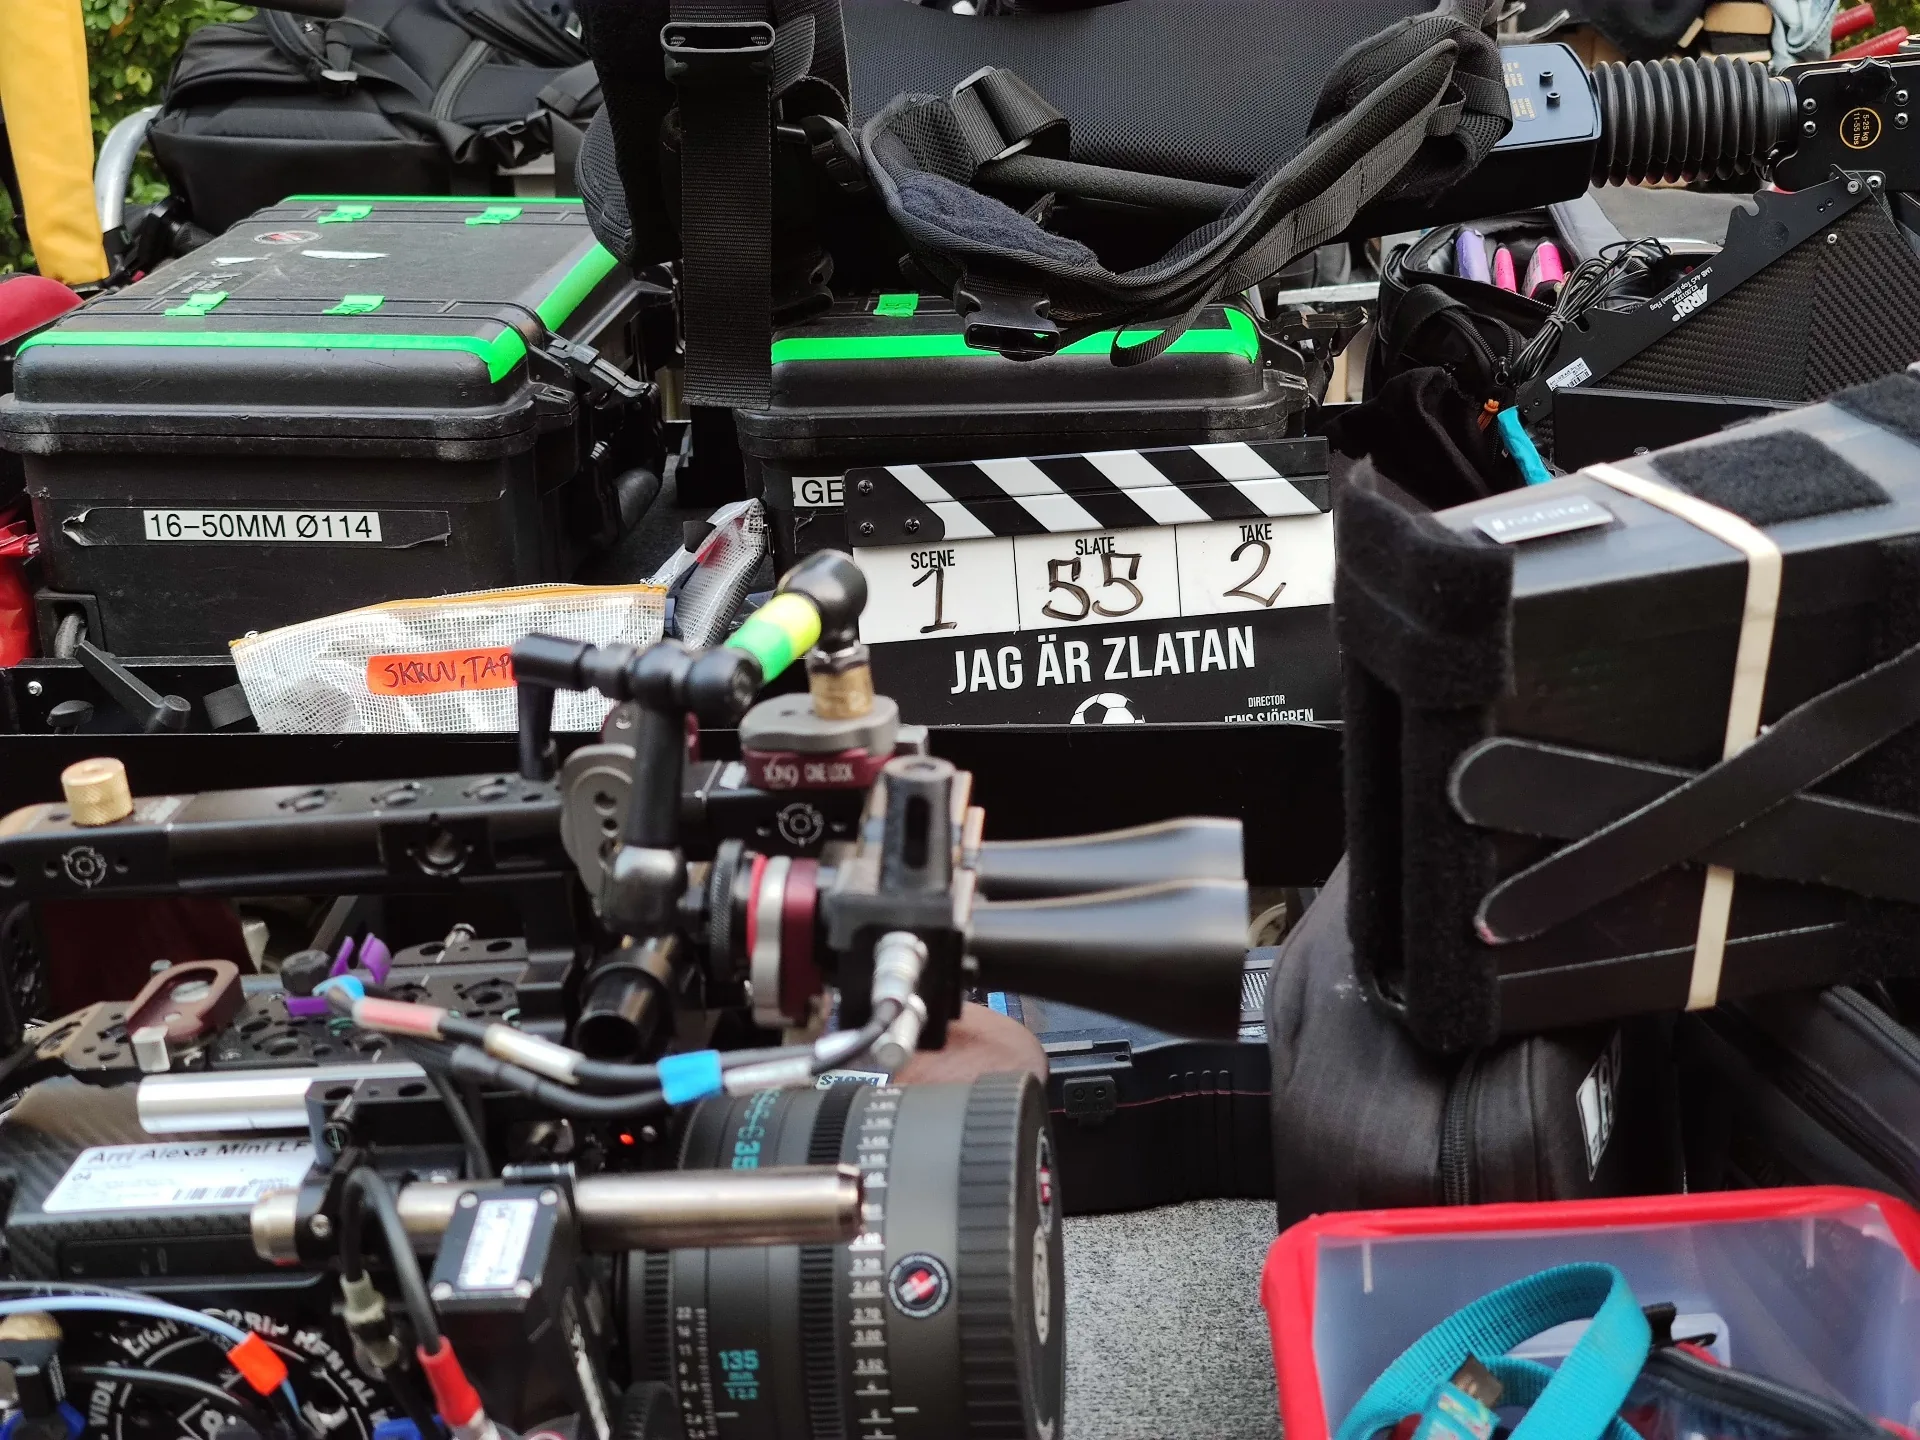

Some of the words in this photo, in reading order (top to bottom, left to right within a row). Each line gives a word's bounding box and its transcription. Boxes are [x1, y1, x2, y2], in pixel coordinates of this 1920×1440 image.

[1853, 112, 1861, 132] 11-55
[1862, 114, 1870, 130] 5-25
[1853, 133, 1861, 145] lbs
[1861, 131, 1870, 141] kg
[1680, 281, 1692, 290] Top
[1649, 300, 1663, 311] Flag
[1674, 283, 1708, 318] ARRI
[149, 513, 287, 538] 16-50MM
[296, 514, 373, 539] Ø114
[1239, 523, 1273, 542] TAKE
[1075, 536, 1116, 556] SLATE
[910, 549, 956, 569] SCENE
[912, 567, 958, 633] 1
[1042, 553, 1144, 621] 55
[1223, 540, 1287, 607] 2
[463, 652, 512, 684] TAP
[950, 645, 1024, 695] JAG
[1036, 634, 1092, 687] ÄR
[1102, 625, 1256, 681] ZLATAN
[1248, 694, 1286, 708] DIRECTOR
[141, 1146, 208, 1160] Alexa
[216, 1141, 271, 1156] Mini
[718, 1349, 760, 1371] 135
